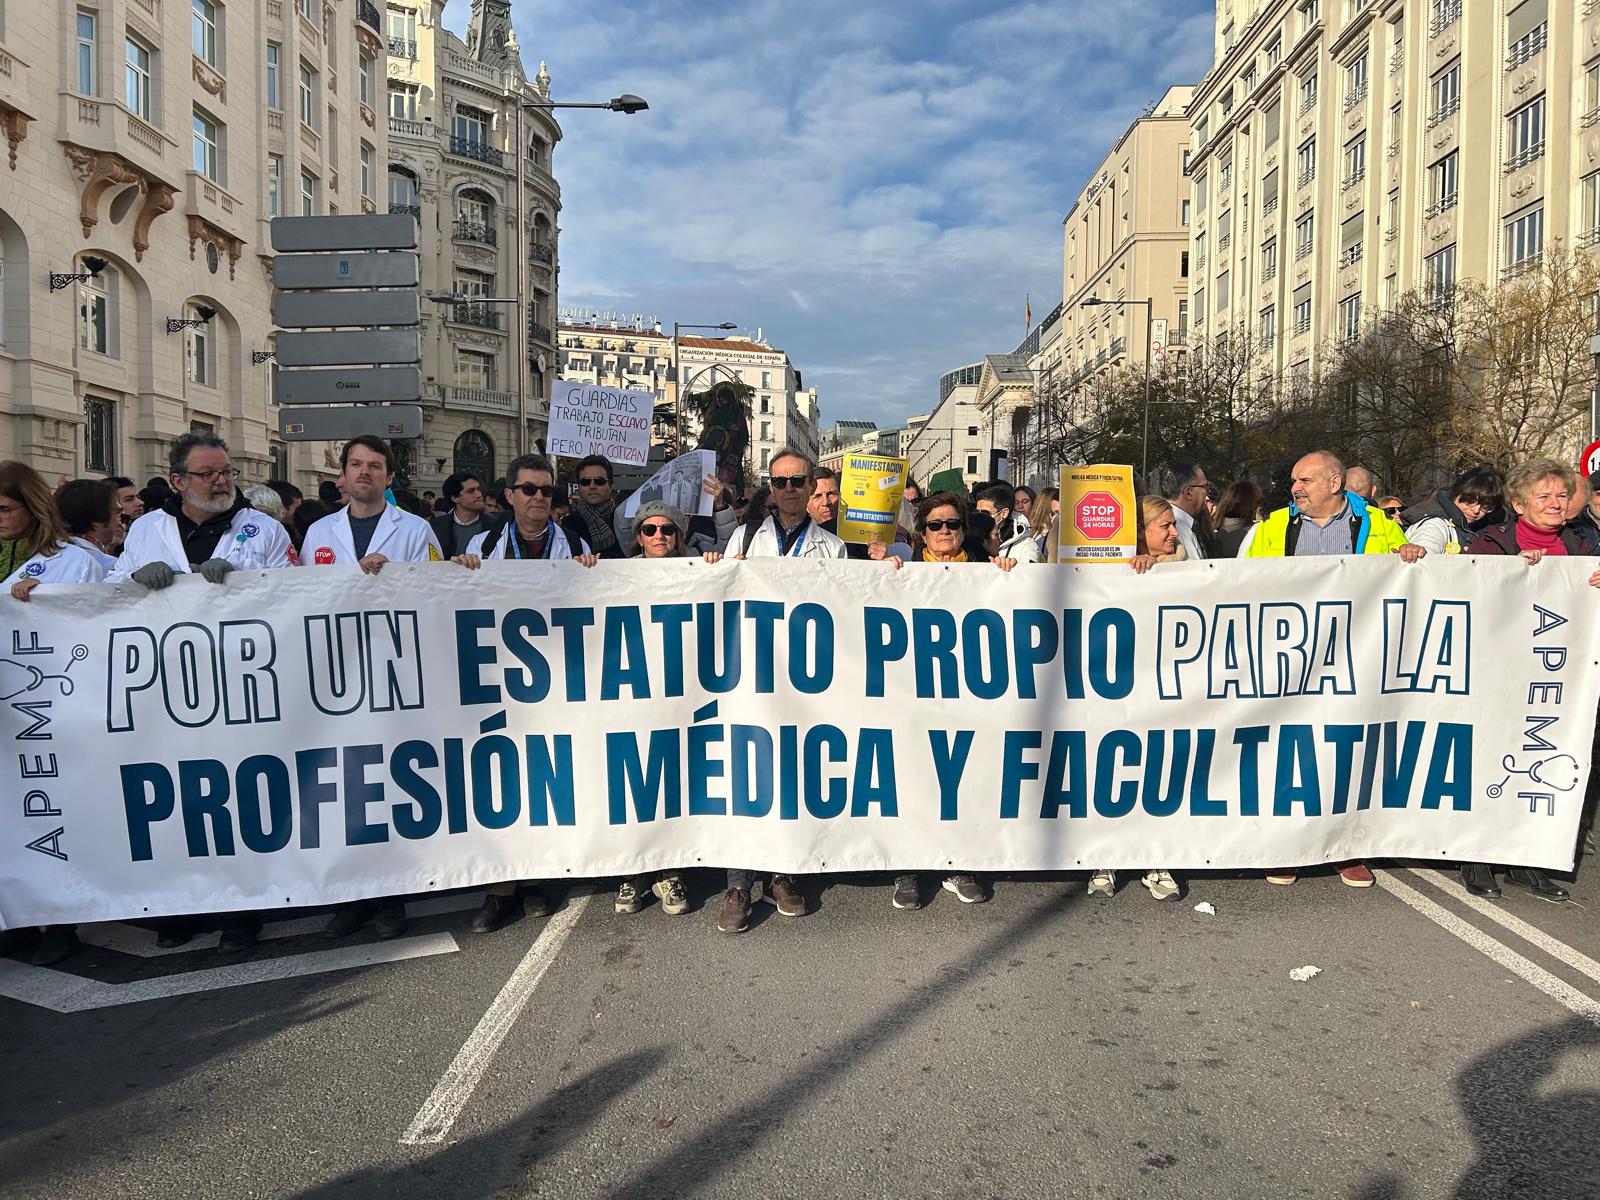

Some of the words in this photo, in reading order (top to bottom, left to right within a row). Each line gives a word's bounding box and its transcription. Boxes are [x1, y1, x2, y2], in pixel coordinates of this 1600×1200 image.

[568, 388, 638, 412] GUARDIAS
[555, 406, 604, 424] TRABAJO
[608, 414, 648, 430] ESCLAVO
[577, 424, 626, 442] TRIBUTAN
[552, 438, 582, 454] PERO
[589, 442, 604, 456] NO
[607, 444, 646, 462] COTIZAN
[850, 459, 904, 474] MANIFESTACIÓN
[1083, 506, 1115, 515] STOP
[107, 619, 281, 732] POR
[304, 610, 425, 715] UN
[455, 600, 834, 706] ESTATUTO
[864, 606, 1136, 700] PROPIO
[1156, 601, 1357, 700] PARA
[1381, 599, 1471, 696] LA
[120, 709, 576, 862] PROFESIÓN
[605, 699, 899, 826] MÉDICA
[928, 729, 975, 821] Y
[1000, 720, 1474, 818] FACULTATIVA
